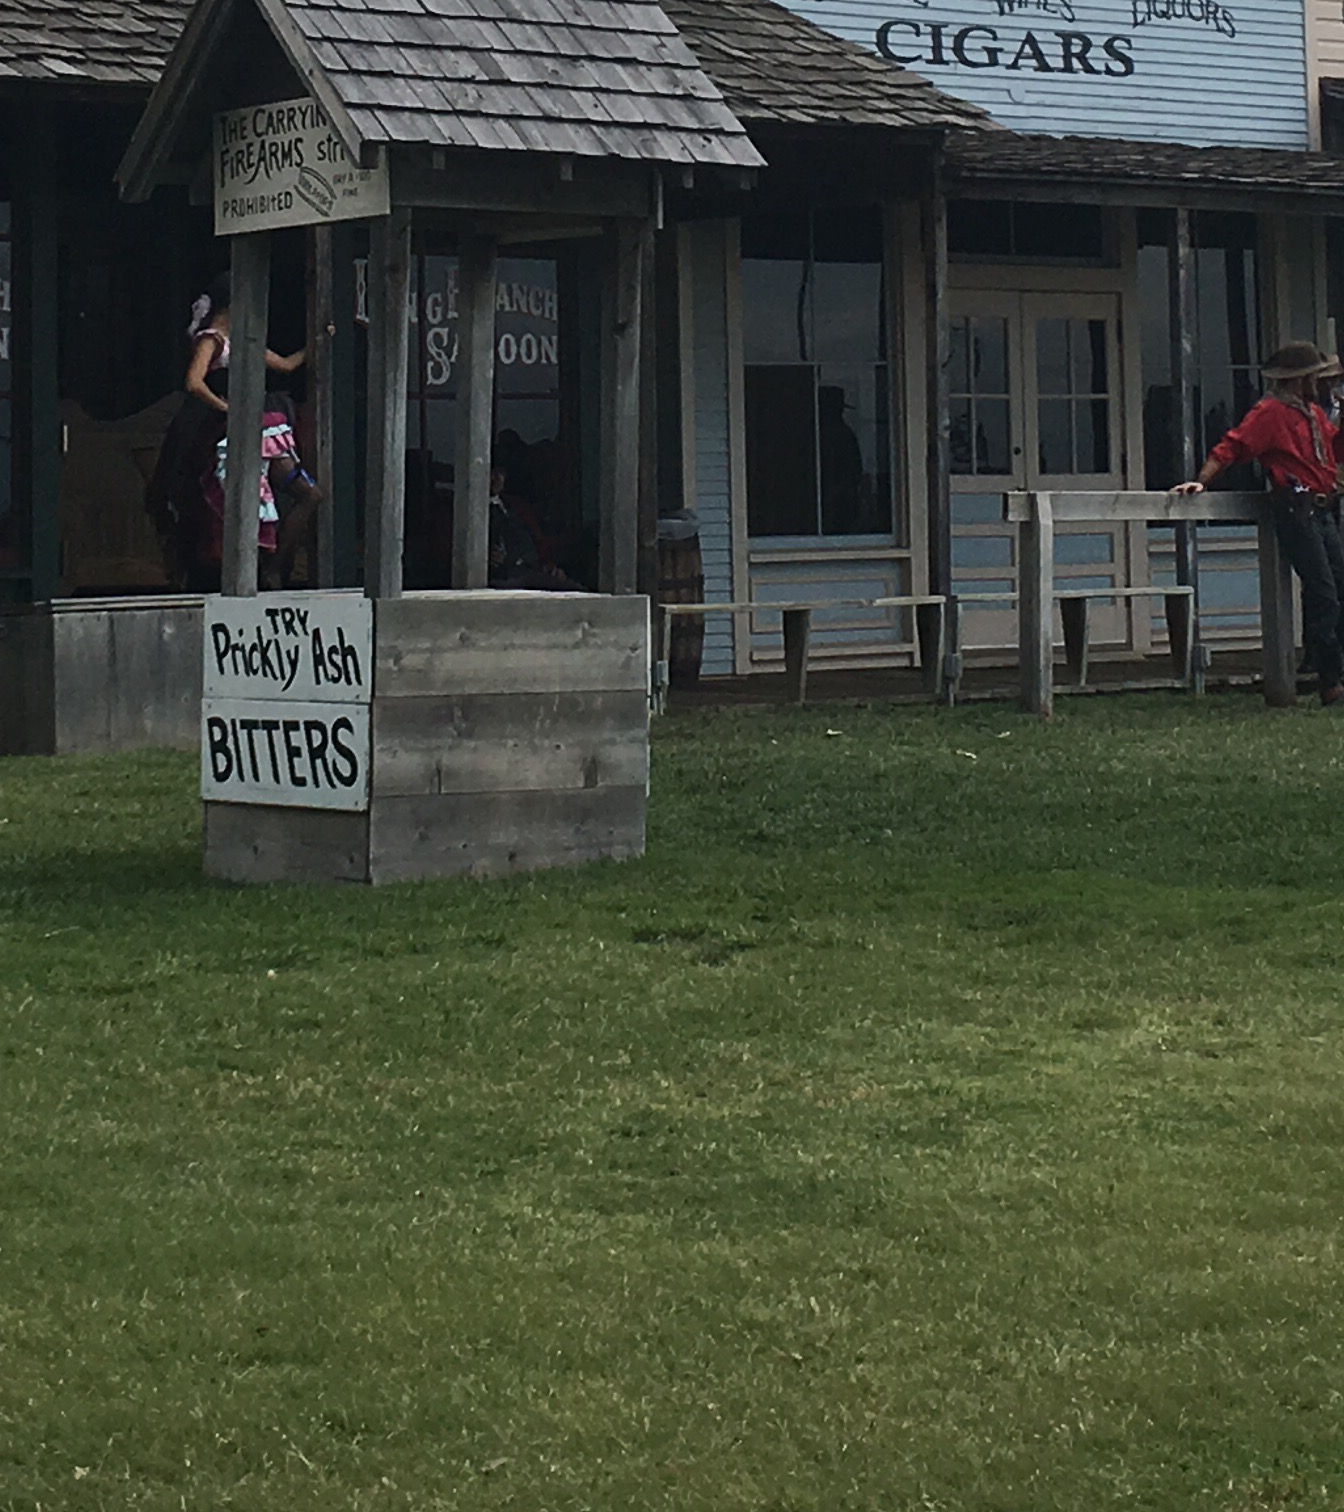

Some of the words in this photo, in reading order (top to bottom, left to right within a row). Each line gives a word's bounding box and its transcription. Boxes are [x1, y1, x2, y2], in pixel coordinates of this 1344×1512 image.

[876, 20, 1136, 76] CIGARS
[220, 117, 247, 145] THE
[253, 105, 326, 138] CARRYIN
[220, 137, 304, 188] FIREARMS
[266, 607, 309, 637] TRY
[211, 623, 299, 692] Prickly
[311, 627, 362, 686] Ash
[207, 716, 358, 789] BITTERS
